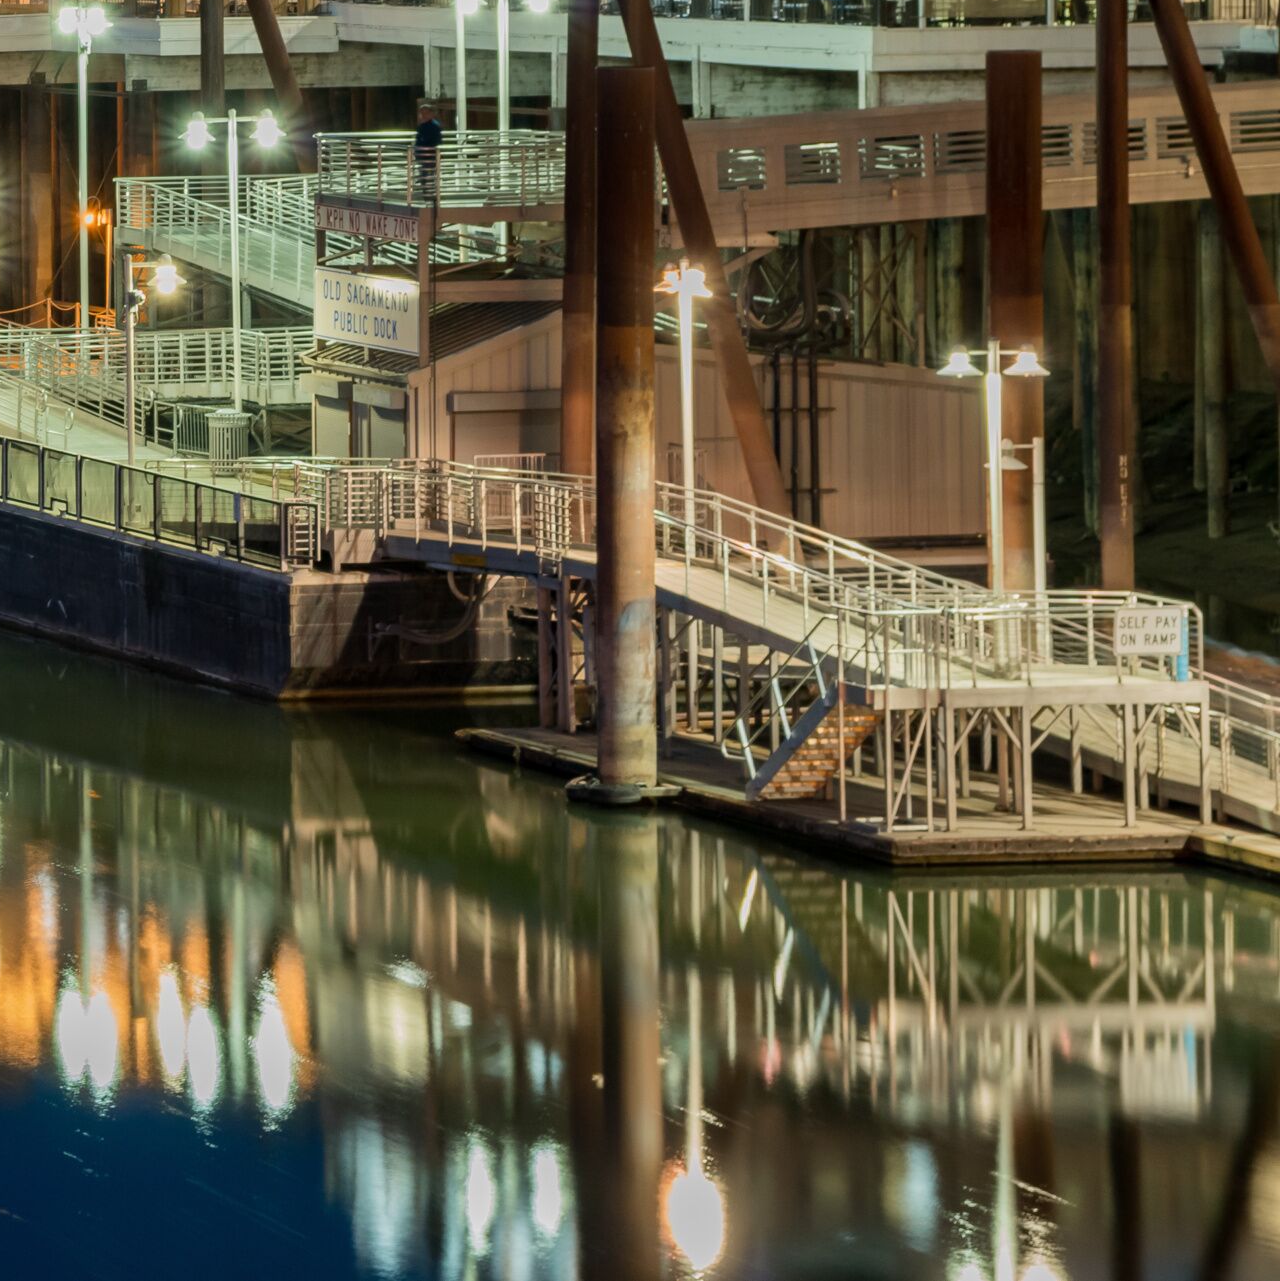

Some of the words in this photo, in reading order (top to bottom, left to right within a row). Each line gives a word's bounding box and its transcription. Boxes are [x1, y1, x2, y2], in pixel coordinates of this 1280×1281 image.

[348, 210, 361, 232] NO
[365, 213, 388, 236] WAKE
[393, 218, 417, 241] ZONE
[323, 279, 341, 301] OLD
[347, 282, 409, 313] SACRAMENTO
[334, 310, 368, 336] PUBLIC
[374, 316, 398, 340] DOCK
[1120, 616, 1148, 629] SELF
[1155, 616, 1177, 628] PAY
[1120, 633, 1136, 646] ON
[1144, 633, 1177, 646] RAMP
